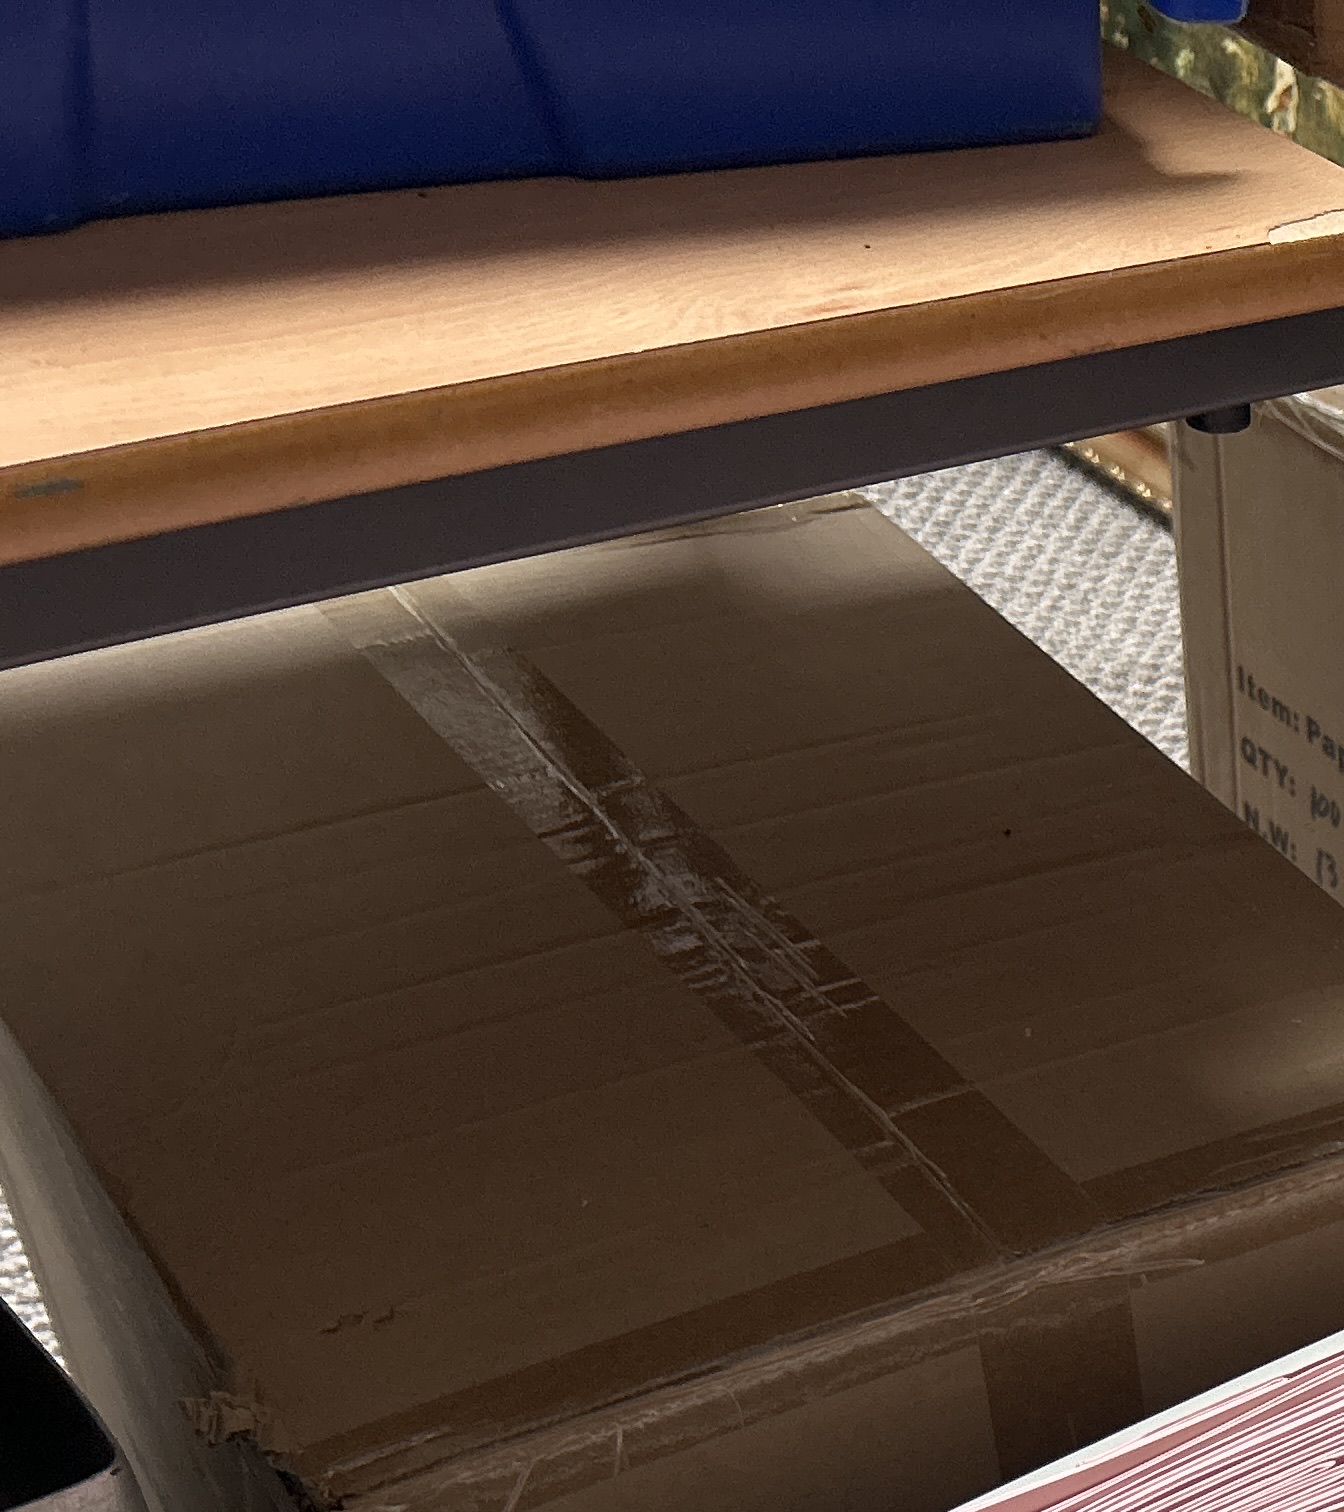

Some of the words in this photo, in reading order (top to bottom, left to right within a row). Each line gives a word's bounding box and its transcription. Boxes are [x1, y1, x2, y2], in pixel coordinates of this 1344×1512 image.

[1236, 664, 1300, 733] Item:
[1240, 736, 1296, 797] QTY:
[1243, 801, 1297, 862] N.W:
